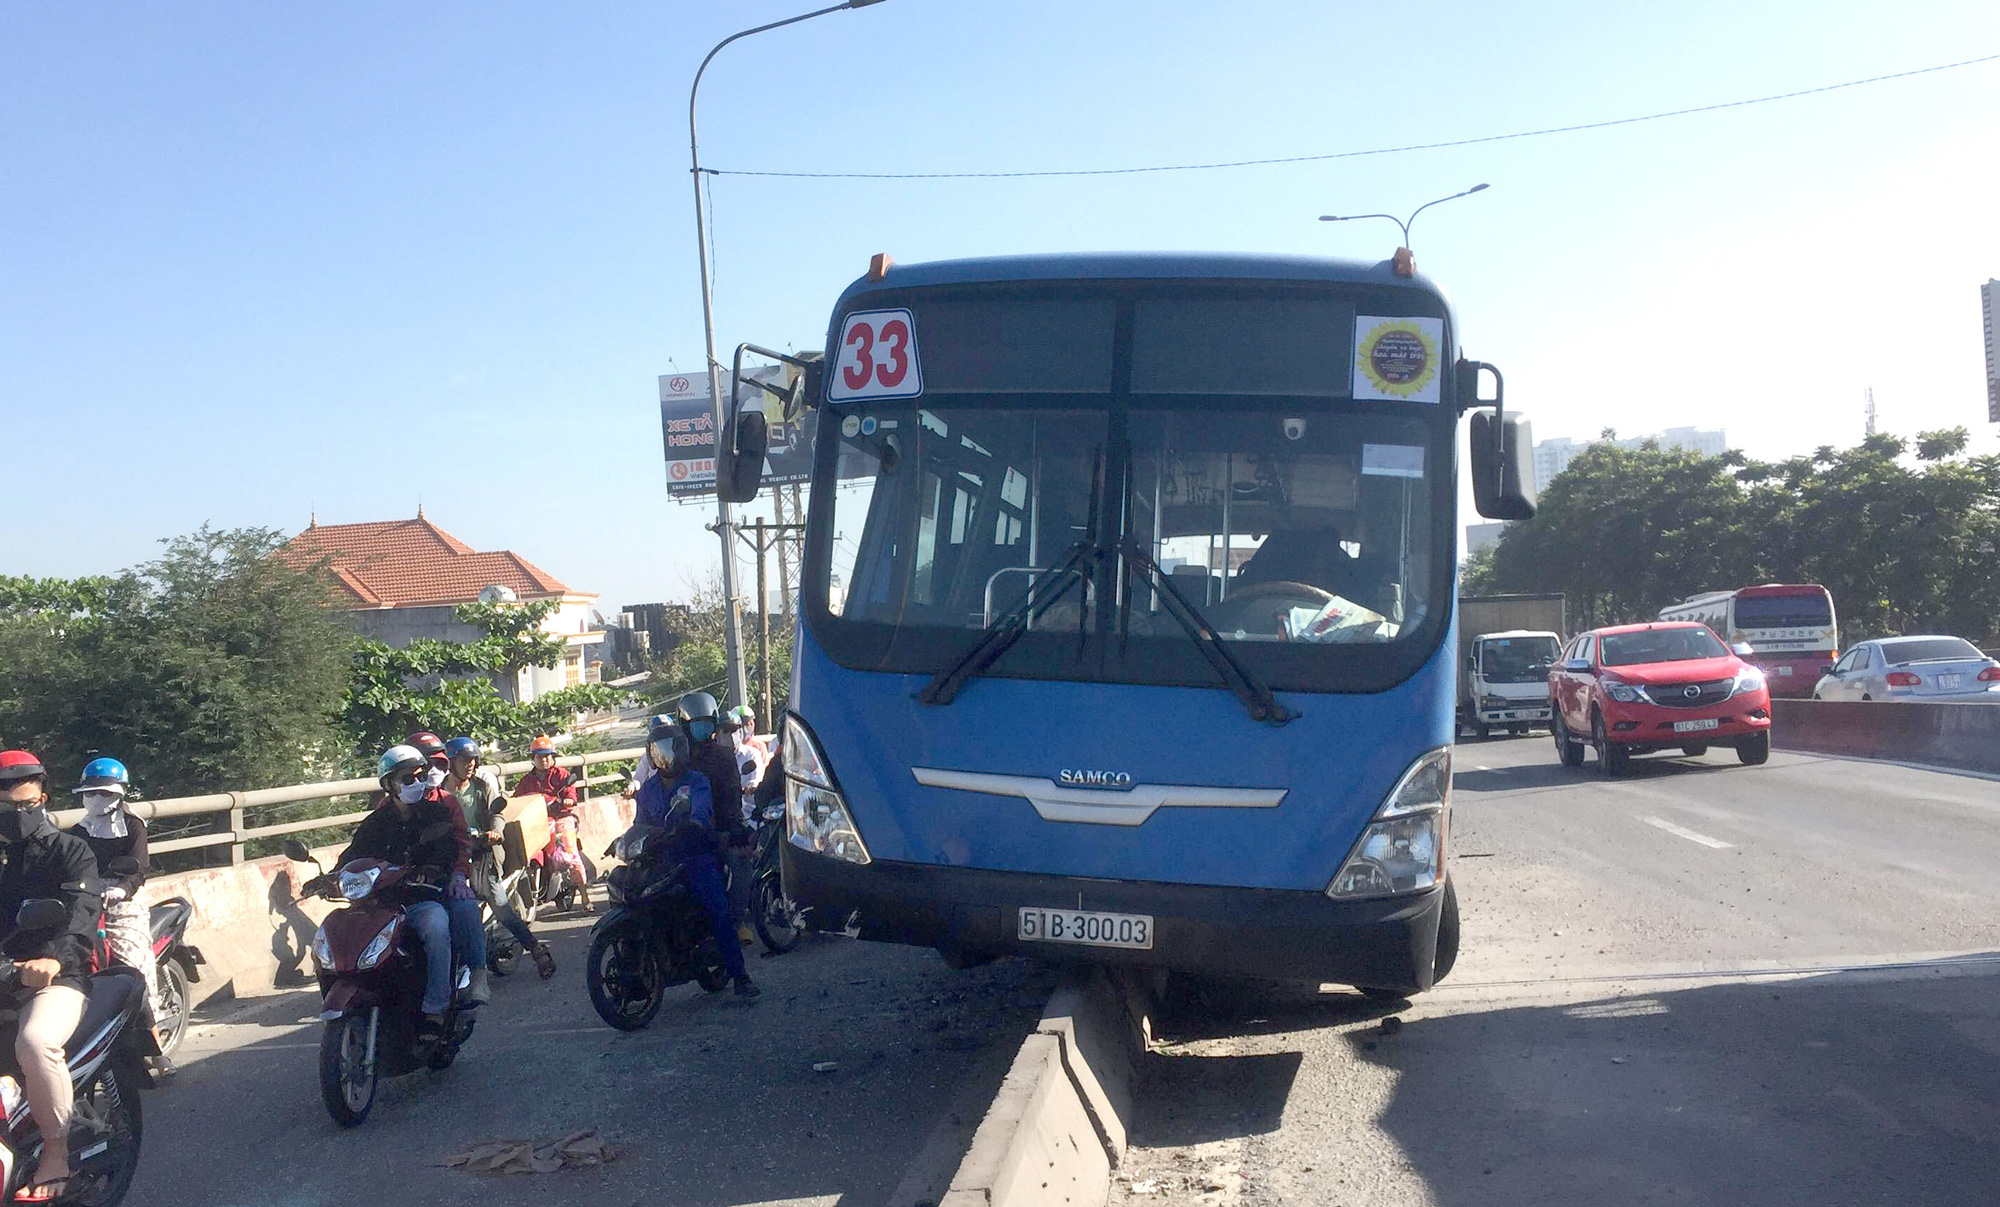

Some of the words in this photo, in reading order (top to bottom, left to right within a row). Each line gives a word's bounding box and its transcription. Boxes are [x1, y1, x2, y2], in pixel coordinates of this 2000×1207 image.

[843, 320, 908, 390] 33
[667, 420, 691, 433] XE
[1059, 768, 1131, 786] SAMCO
[1023, 912, 1147, 944] 51B-300.03
